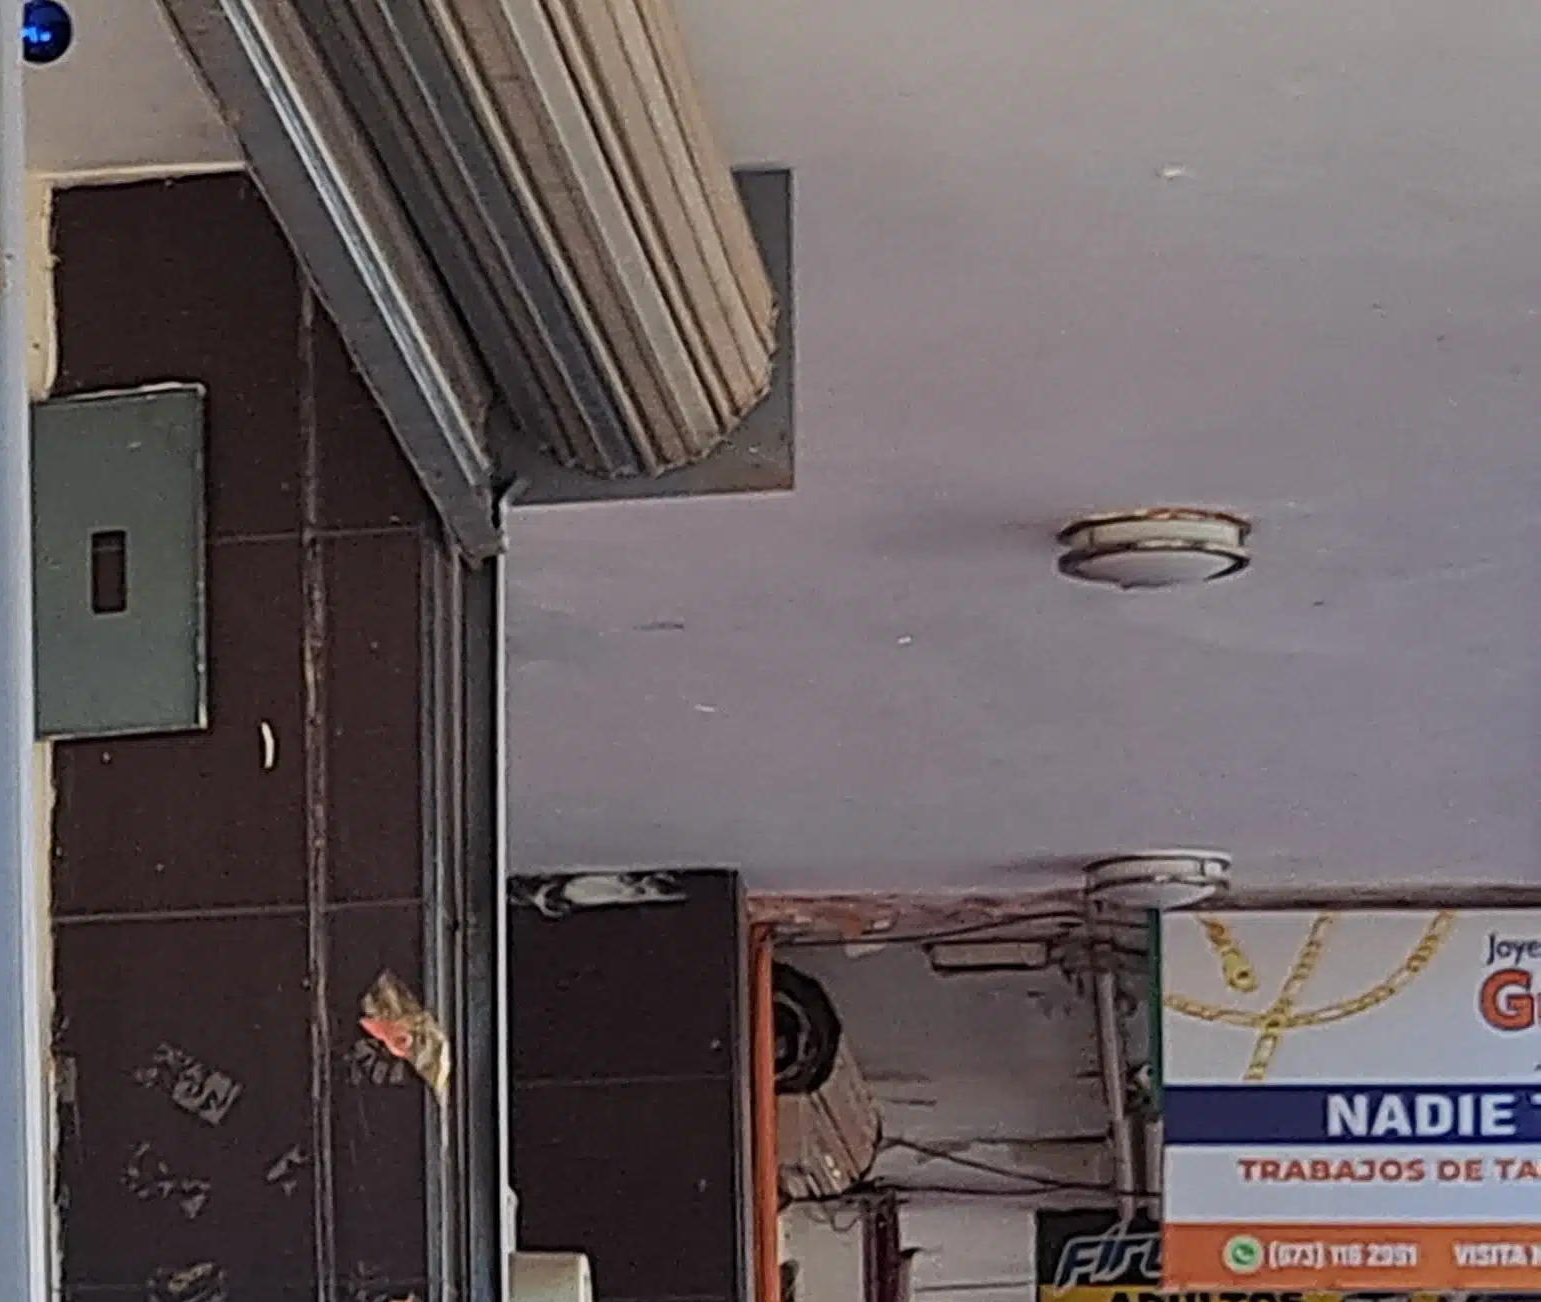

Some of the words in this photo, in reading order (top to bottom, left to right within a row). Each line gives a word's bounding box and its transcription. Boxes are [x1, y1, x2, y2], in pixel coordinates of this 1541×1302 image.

[1326, 1092, 1518, 1137] NADIE
[1237, 1158, 1426, 1183] TRABAJOS
[1437, 1159, 1483, 1183] DE
